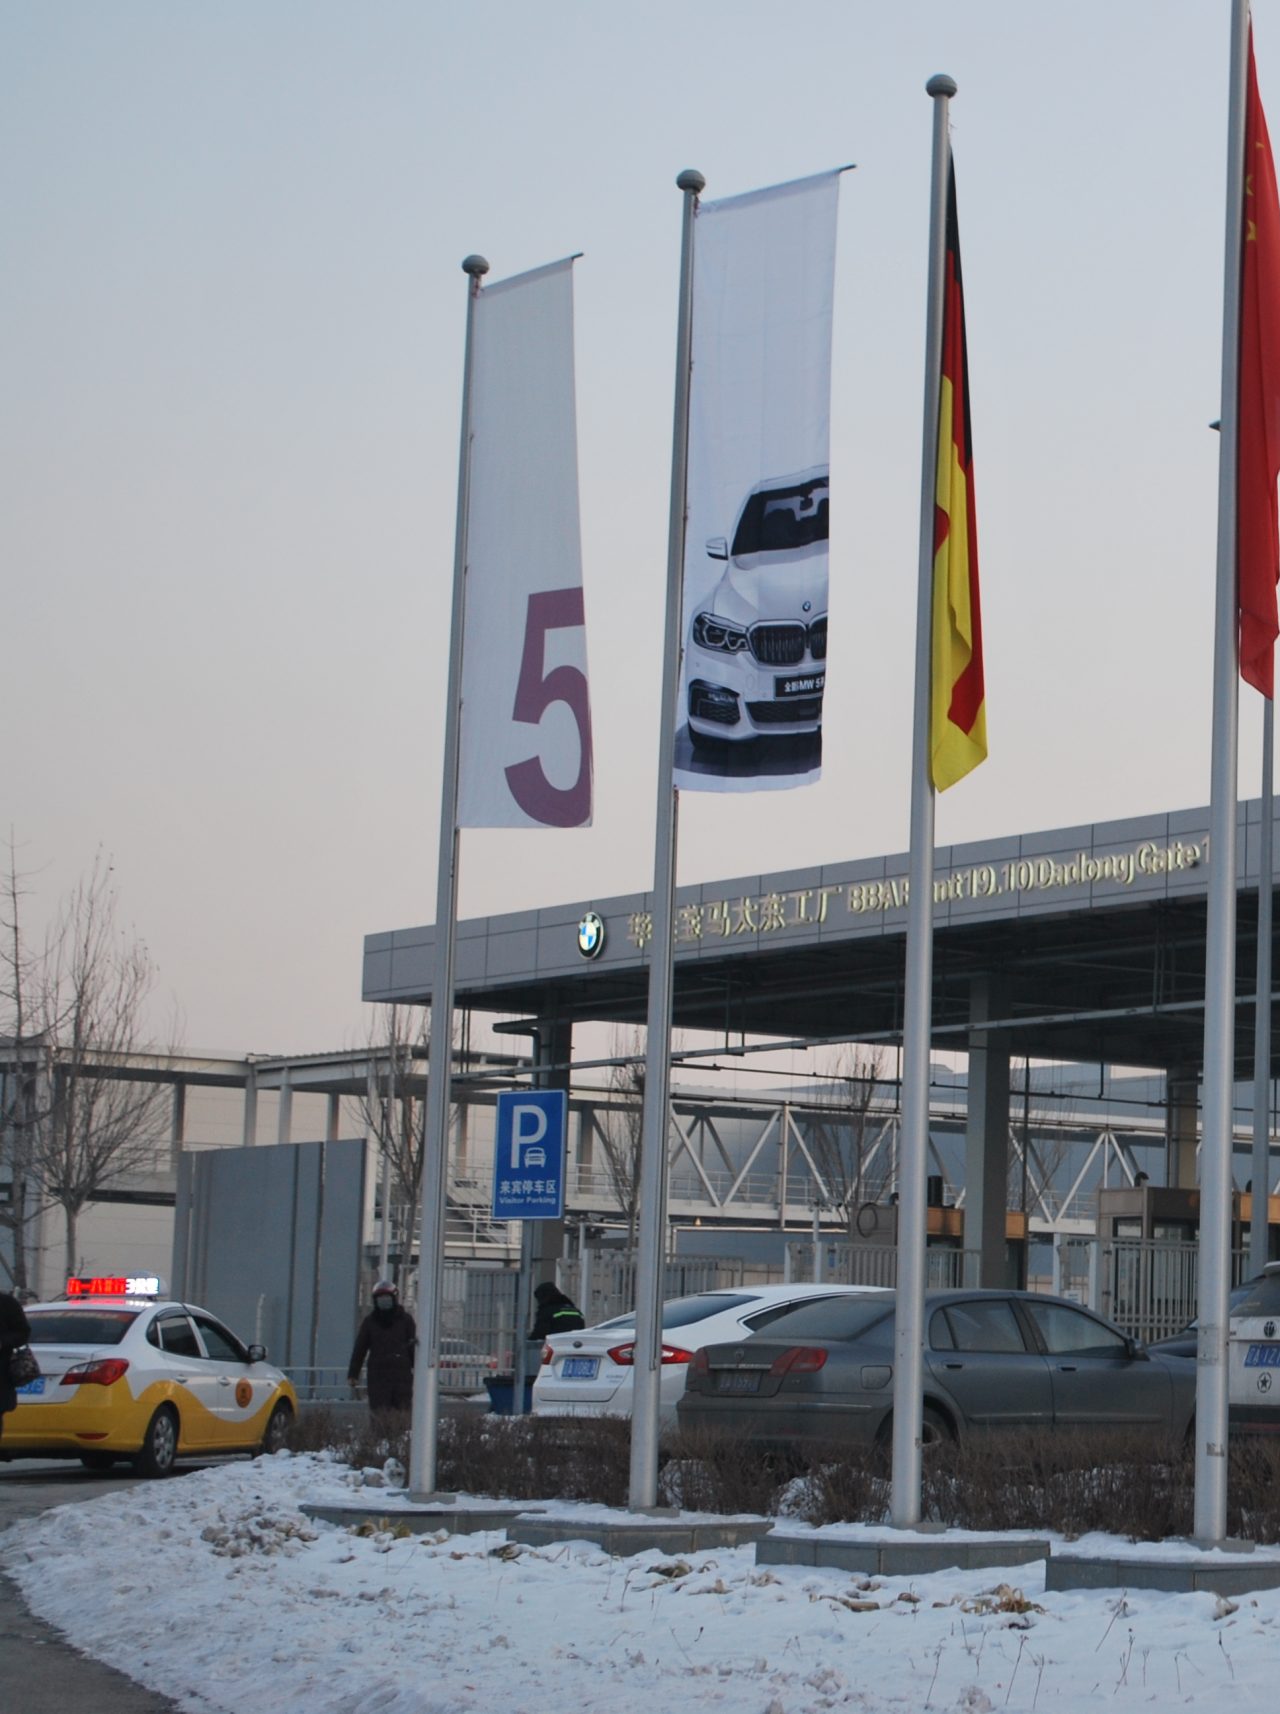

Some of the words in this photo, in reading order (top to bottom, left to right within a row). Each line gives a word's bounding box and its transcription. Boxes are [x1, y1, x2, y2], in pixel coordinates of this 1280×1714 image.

[504, 586, 592, 828] 5
[626, 885, 842, 948] 华宝马大东工厂
[1034, 852, 1134, 889] Dadong
[1135, 841, 1200, 875] Gate
[510, 1104, 547, 1169] P
